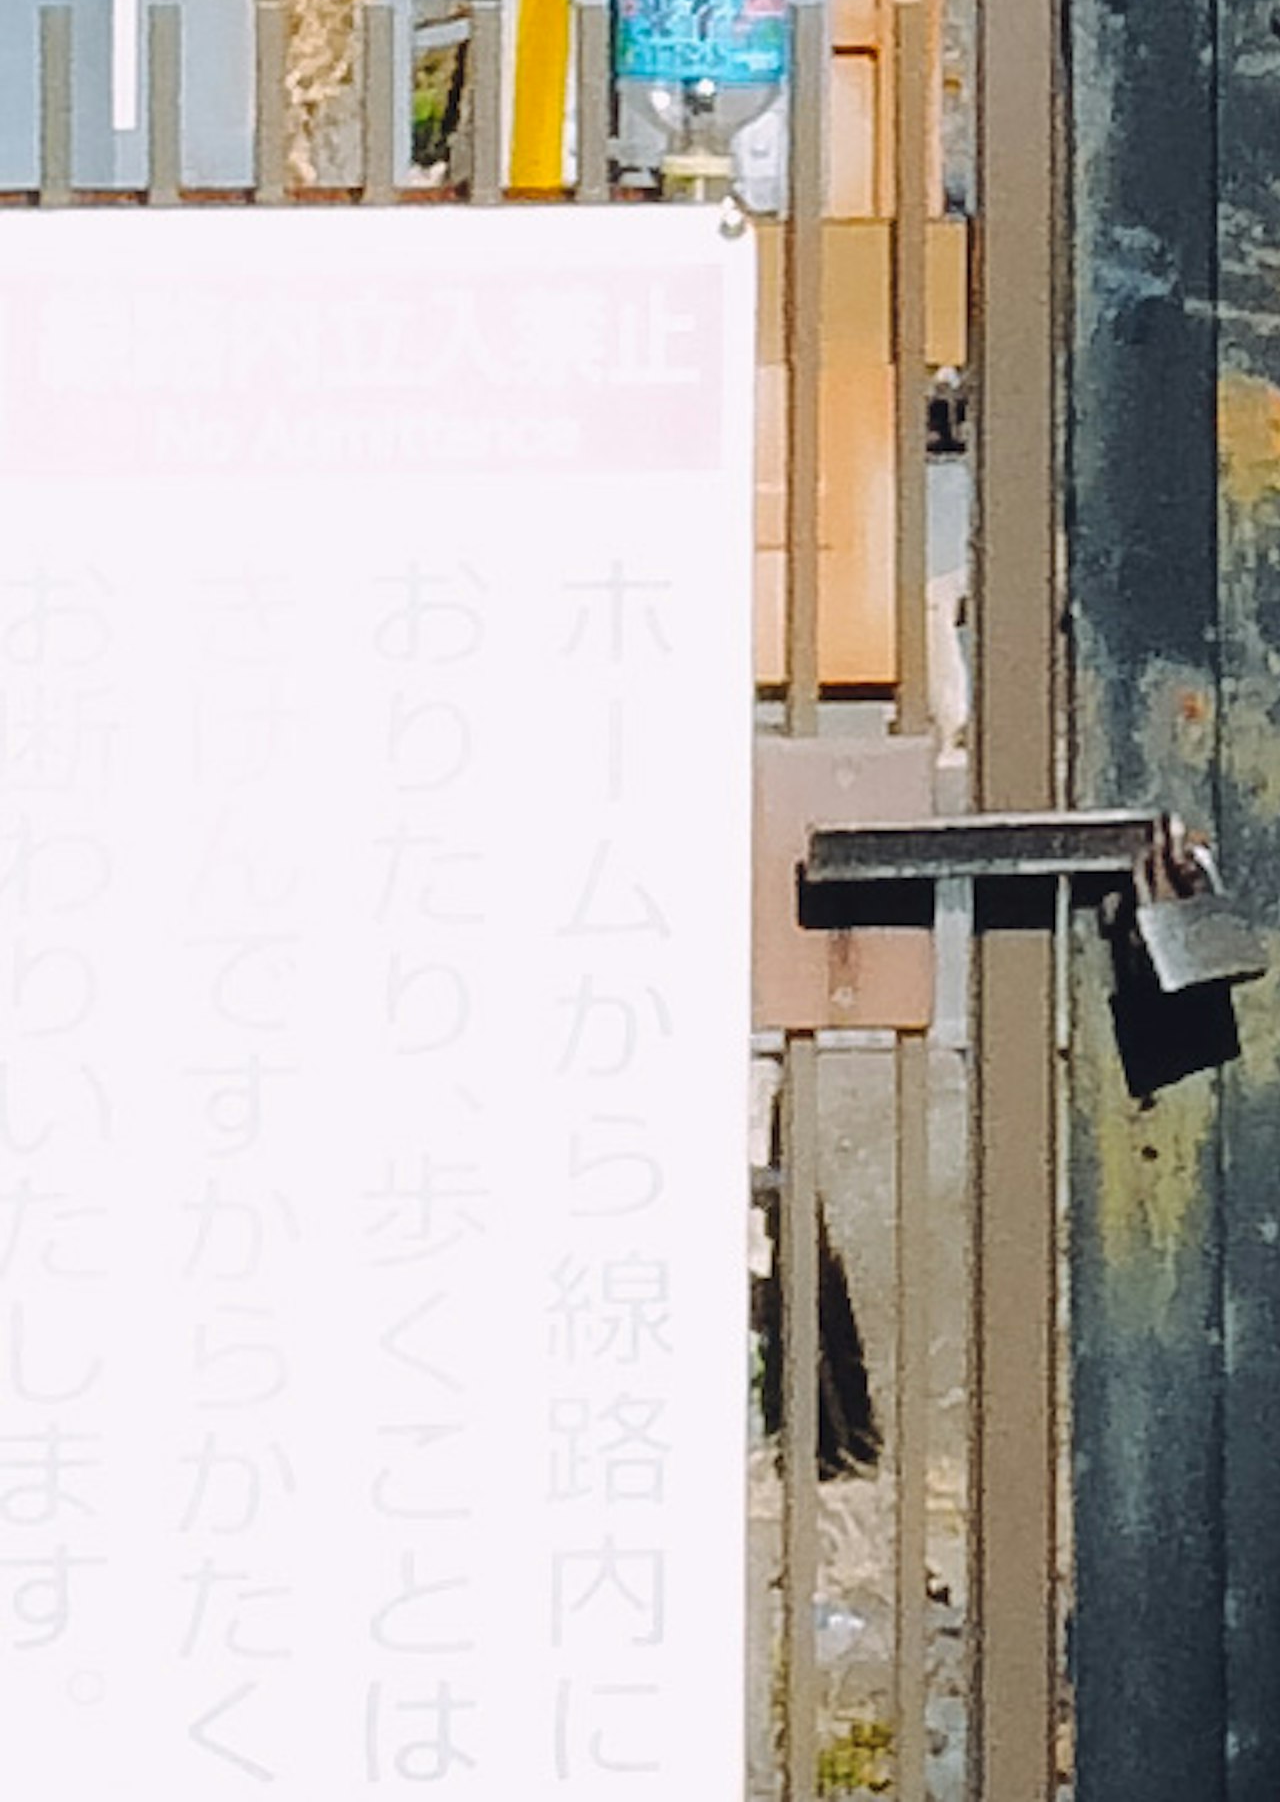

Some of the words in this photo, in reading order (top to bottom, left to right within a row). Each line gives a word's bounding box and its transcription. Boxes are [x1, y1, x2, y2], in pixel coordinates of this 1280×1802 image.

[362, 558, 493, 1784] おりたり、歩くことは
[544, 558, 675, 1782] ホームから線路内に
